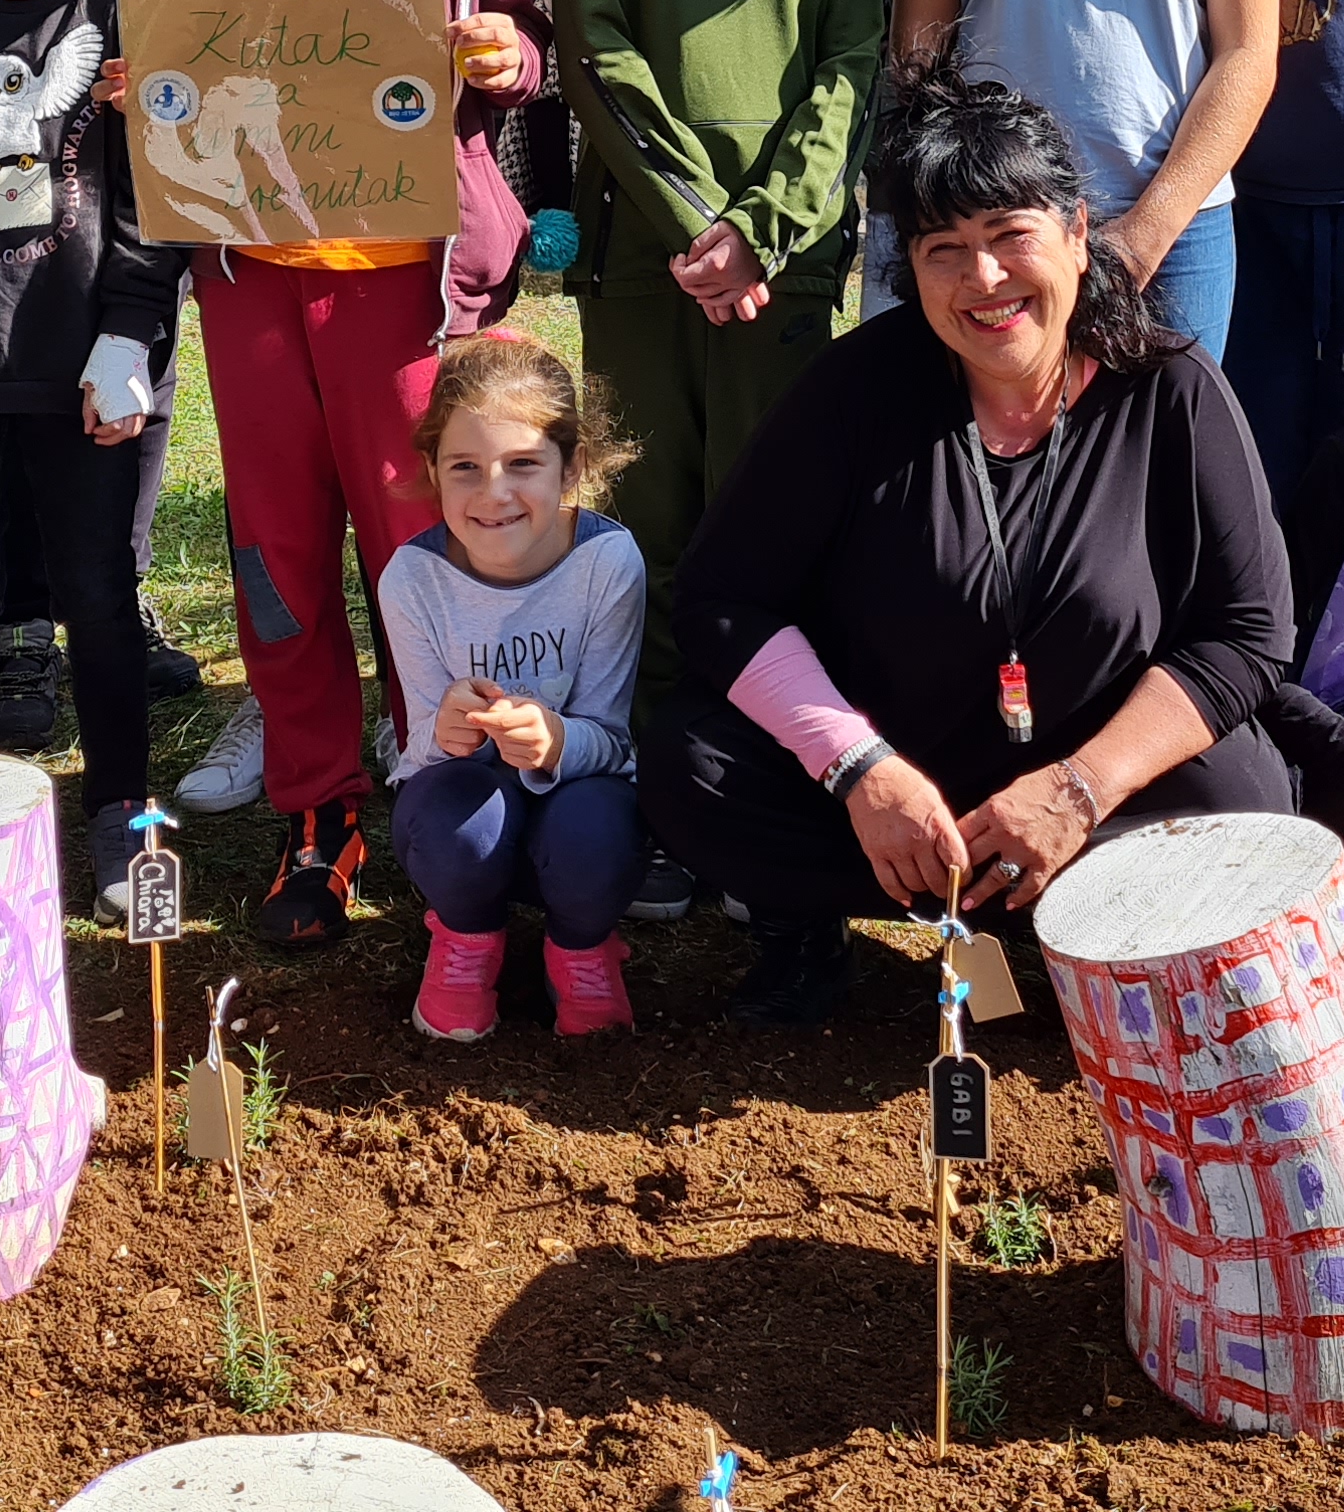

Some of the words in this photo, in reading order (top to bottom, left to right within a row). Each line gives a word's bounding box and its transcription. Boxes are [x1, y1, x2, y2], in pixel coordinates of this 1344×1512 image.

[185, 8, 381, 69] Kutak
[244, 81, 306, 108] za
[224, 160, 430, 212] trenutak
[55, 212, 78, 242] TO
[469, 627, 567, 681] HAPPY
[137, 862, 167, 932] Chiara
[949, 1072, 975, 1136] GABI
